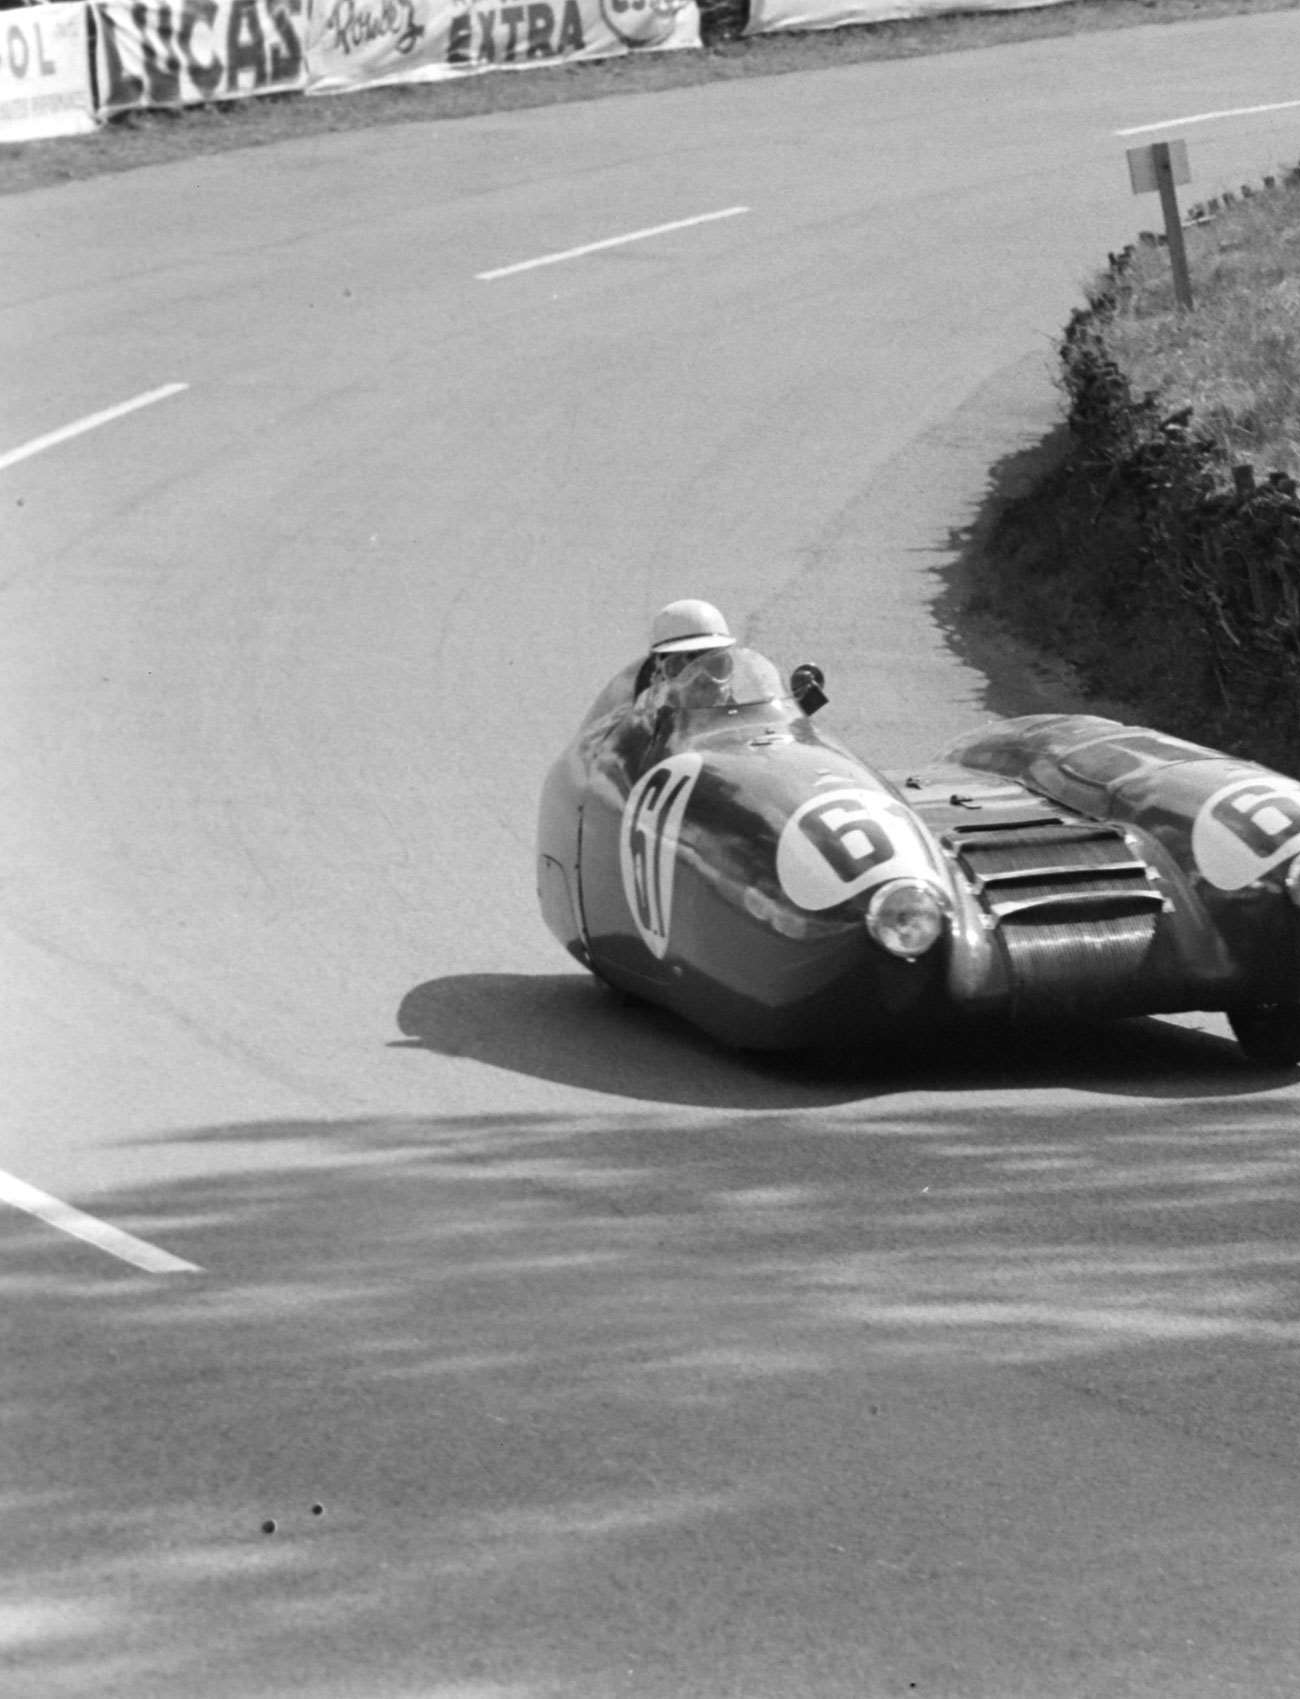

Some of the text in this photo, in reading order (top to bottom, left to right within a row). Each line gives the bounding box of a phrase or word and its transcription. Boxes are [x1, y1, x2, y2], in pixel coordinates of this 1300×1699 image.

[0, 22, 56, 79] OL
[99, 0, 303, 104] LUCAS
[447, 0, 586, 62] EXTRA
